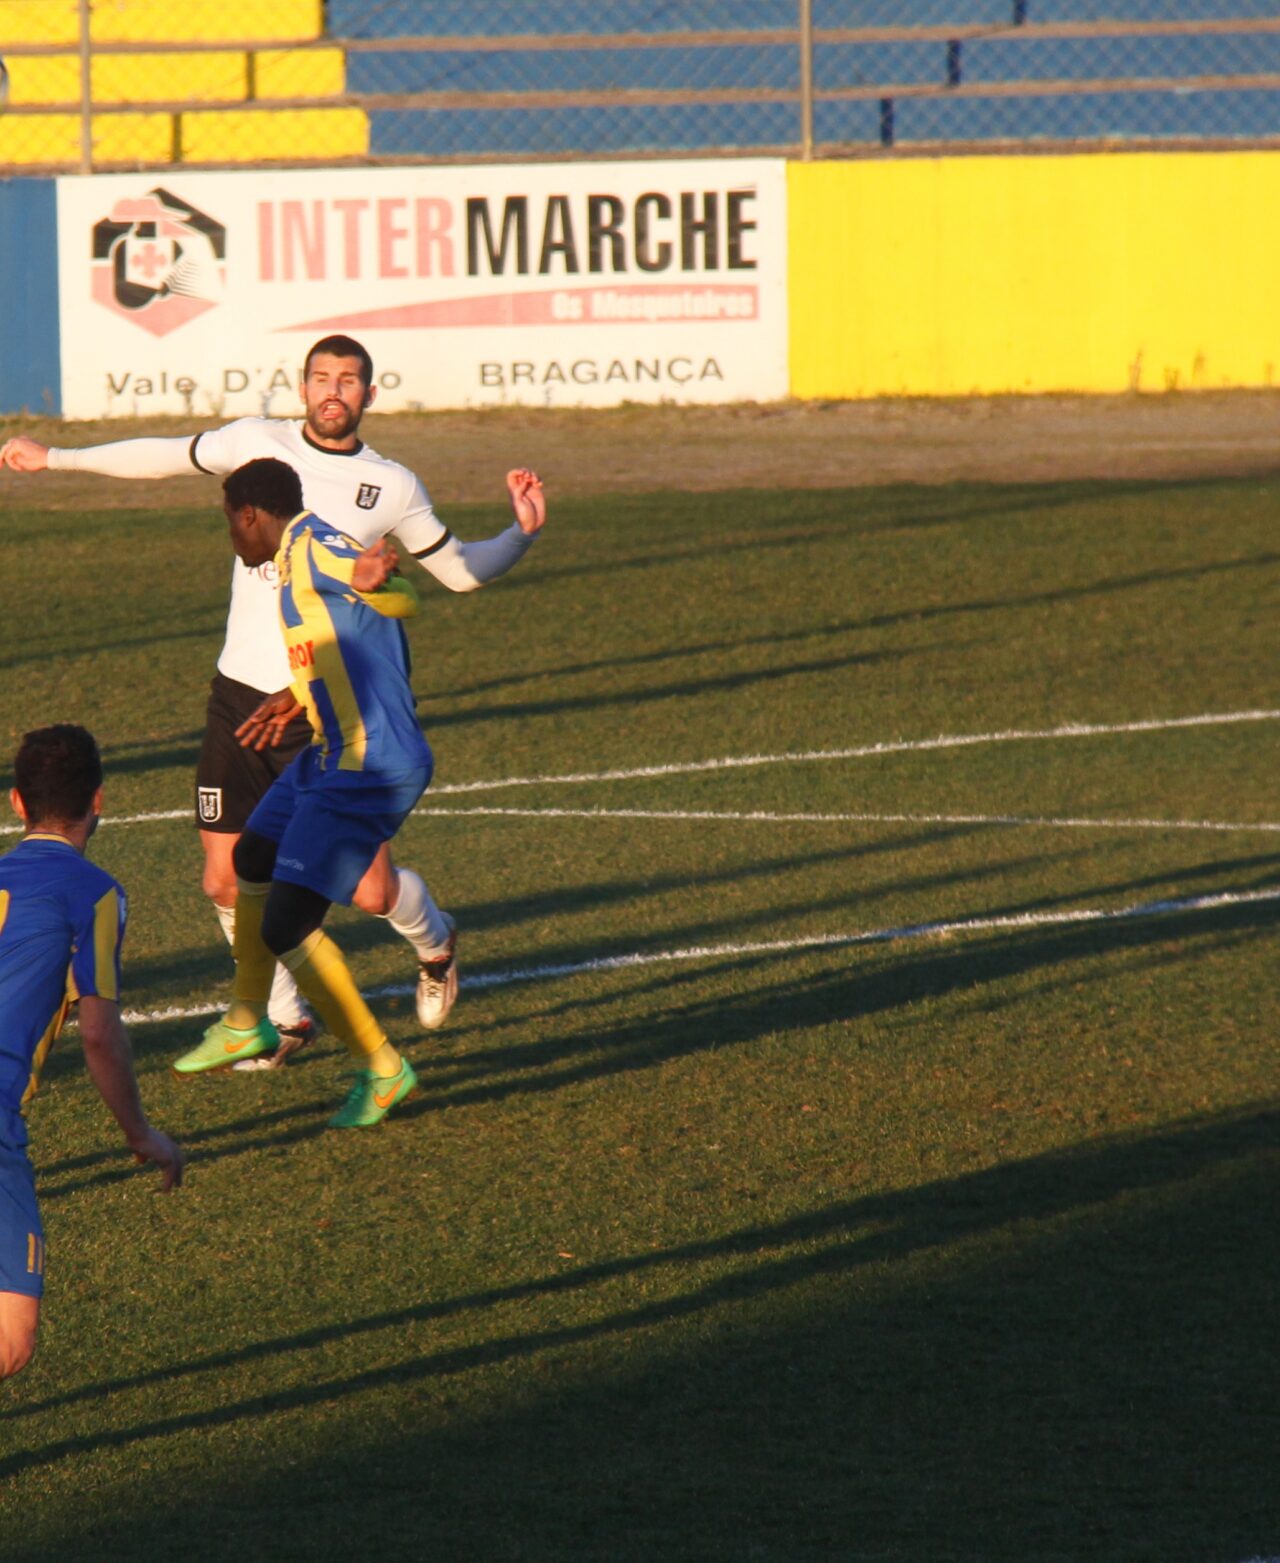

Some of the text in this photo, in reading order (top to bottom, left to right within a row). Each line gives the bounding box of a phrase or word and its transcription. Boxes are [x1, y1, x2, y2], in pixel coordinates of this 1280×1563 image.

[551, 291, 584, 320] Os
[106, 371, 197, 395] Vale
[479, 357, 725, 387] BRAGANÇA
